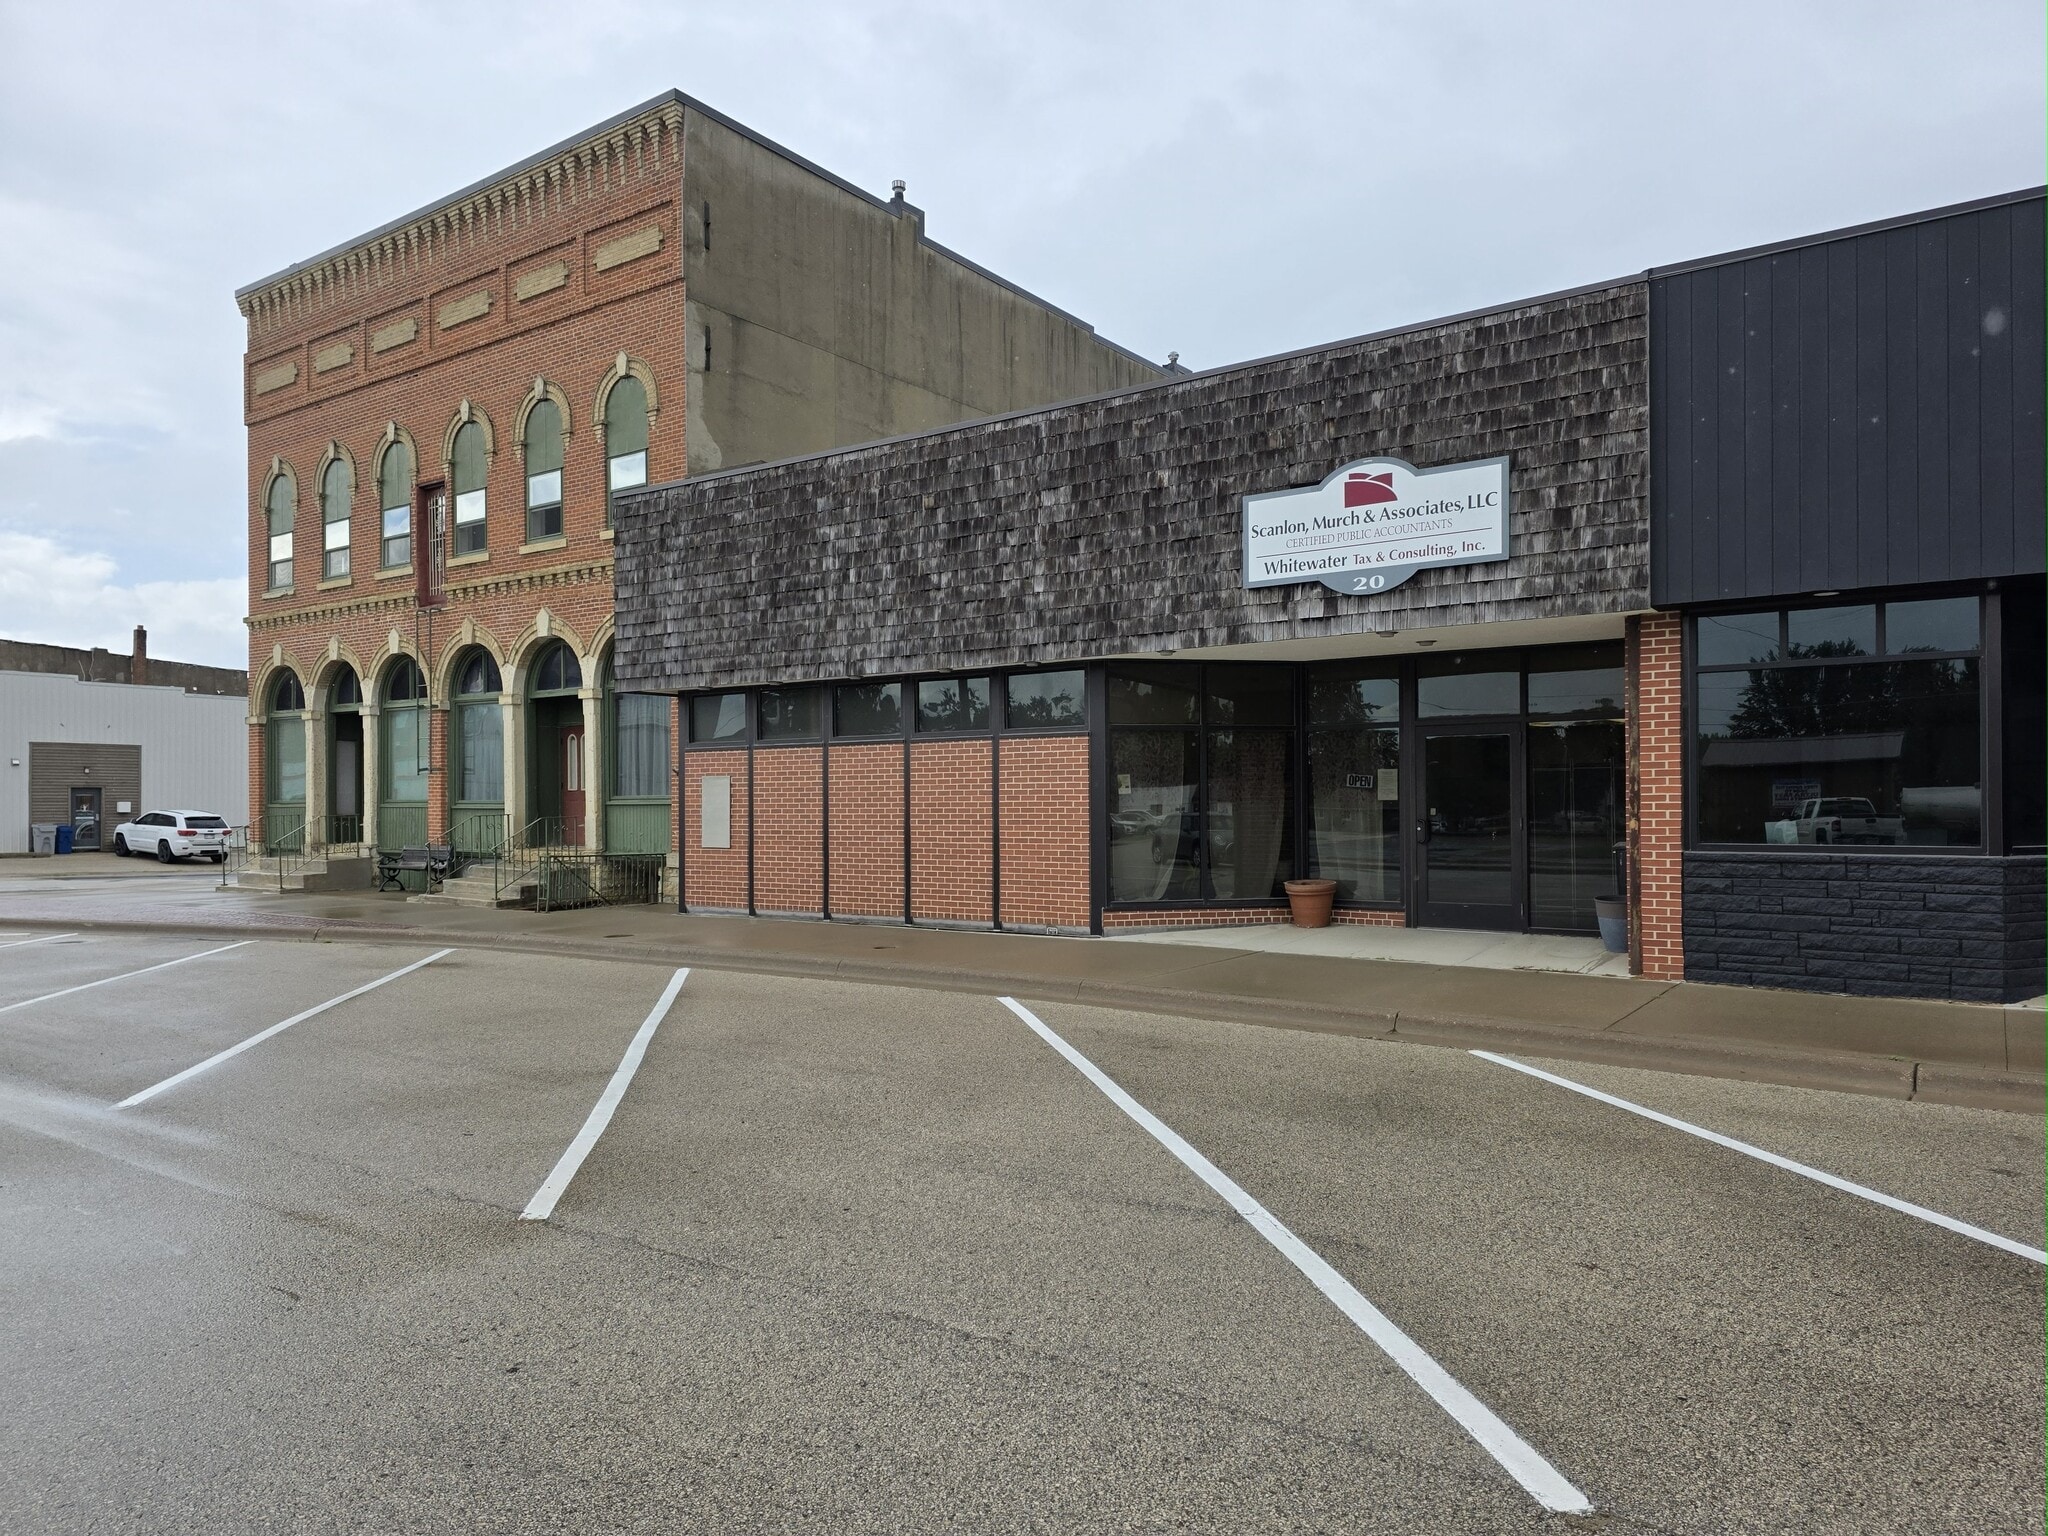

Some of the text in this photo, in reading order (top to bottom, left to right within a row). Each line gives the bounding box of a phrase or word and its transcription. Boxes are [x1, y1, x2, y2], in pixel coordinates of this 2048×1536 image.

[1251, 491, 1498, 539] Scanlon, Murch & Associates, LLC
[1286, 518, 1453, 549] CERTIFIED PUBLIC ACCOUNTANTS
[1264, 541, 1485, 575] Whitewater Tax & Consulting, Inc.
[1353, 574, 1385, 591] 20
[1348, 774, 1371, 787] OPEN
